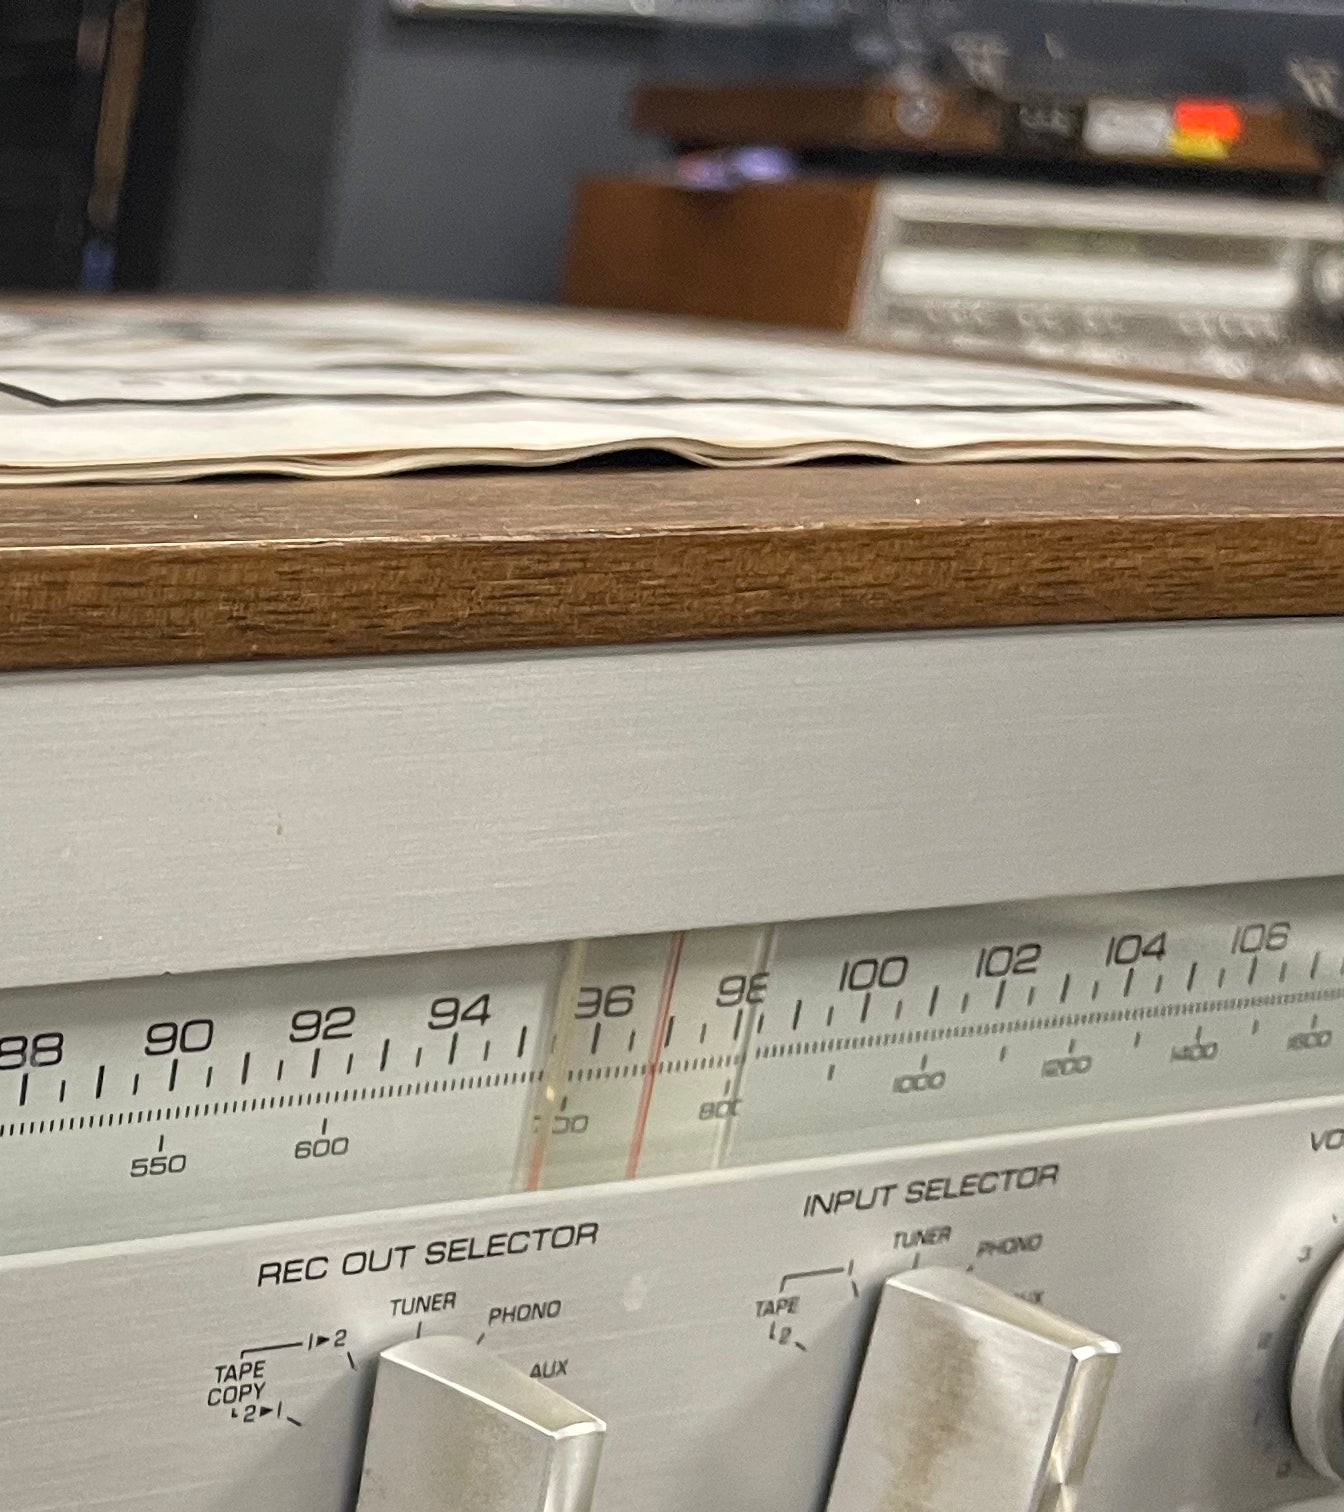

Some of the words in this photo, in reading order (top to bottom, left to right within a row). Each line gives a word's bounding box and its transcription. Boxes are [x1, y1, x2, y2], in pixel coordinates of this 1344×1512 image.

[144, 1018, 214, 1056] 90
[289, 1006, 356, 1043] 92
[427, 993, 491, 1030] 94
[839, 955, 909, 991] 100
[976, 942, 1042, 978] 102
[1105, 931, 1167, 966] 104
[1230, 920, 1292, 955] 106
[130, 1154, 187, 1178] 550
[294, 1137, 349, 1160] 600
[803, 1183, 898, 1217] INPUT
[904, 1163, 1060, 1204] SELECTOR
[257, 1256, 329, 1288] REC
[342, 1245, 416, 1276] OUT
[424, 1222, 599, 1265] SELECTOR
[893, 1226, 952, 1250] TUNER
[976, 1232, 1043, 1258] PHONO
[390, 1291, 457, 1316] TUNER
[488, 1299, 562, 1325] PHONO
[755, 1296, 801, 1318] TAPE
[215, 1360, 266, 1384] TAPE
[529, 1358, 570, 1379] AUX
[207, 1381, 266, 1407] COPY
